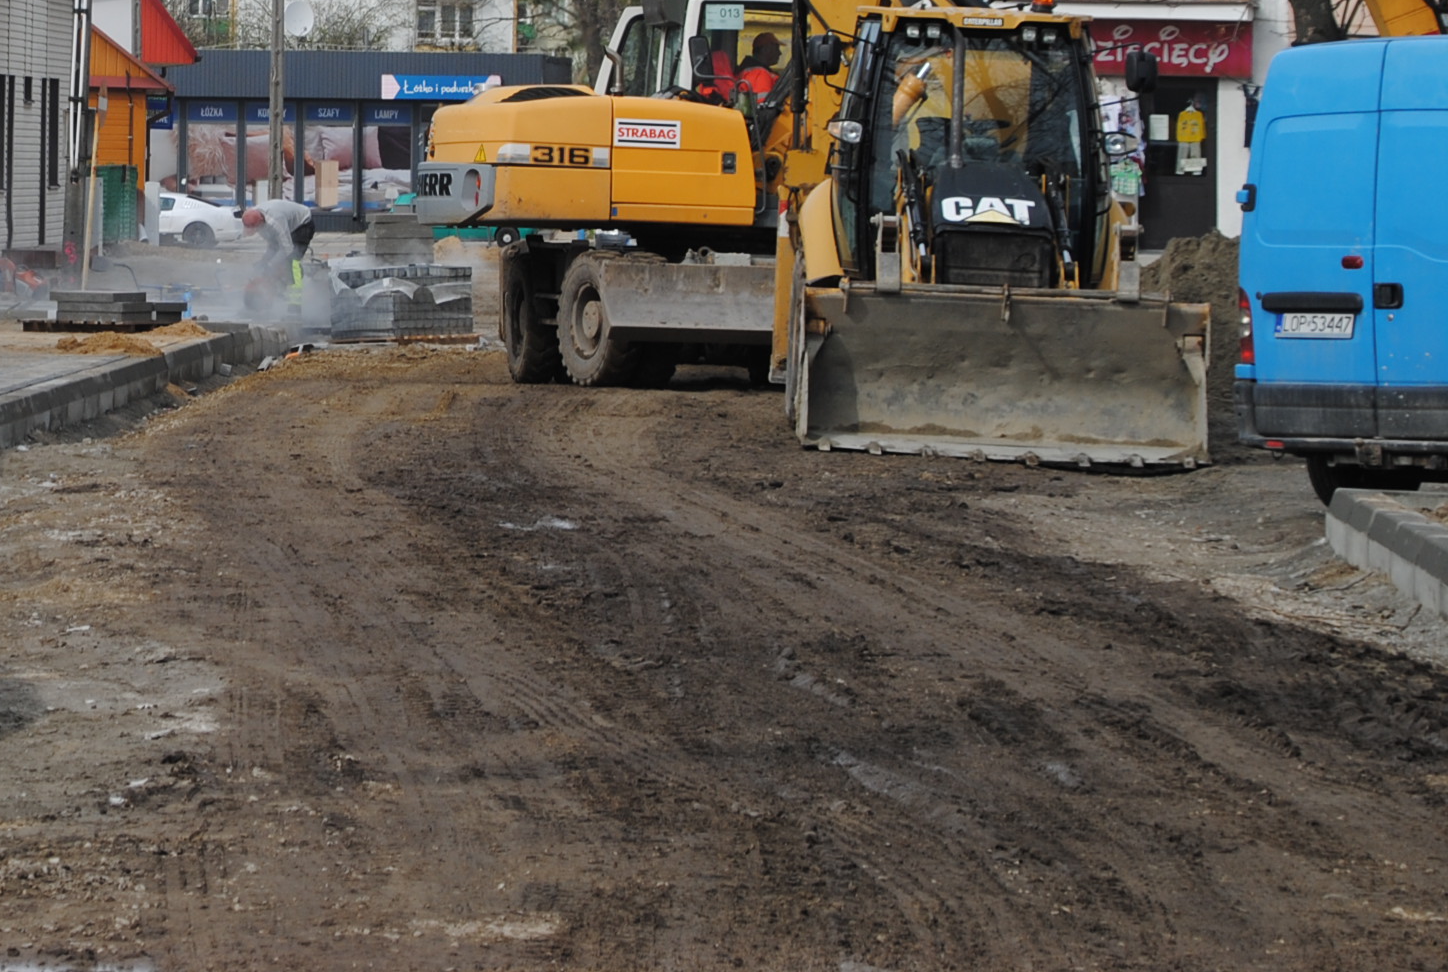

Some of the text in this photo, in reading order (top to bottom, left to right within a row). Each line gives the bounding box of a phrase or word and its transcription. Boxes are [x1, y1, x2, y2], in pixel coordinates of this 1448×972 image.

[719, 7, 741, 19] 013
[200, 105, 224, 118] ŁÓŻKA
[317, 107, 340, 119] SZAFY
[374, 109, 399, 120] LAMPY
[617, 126, 678, 140] STRABAG
[532, 145, 590, 165] 316
[941, 196, 1036, 226] CAT
[1283, 314, 1352, 333] LOP 53447
